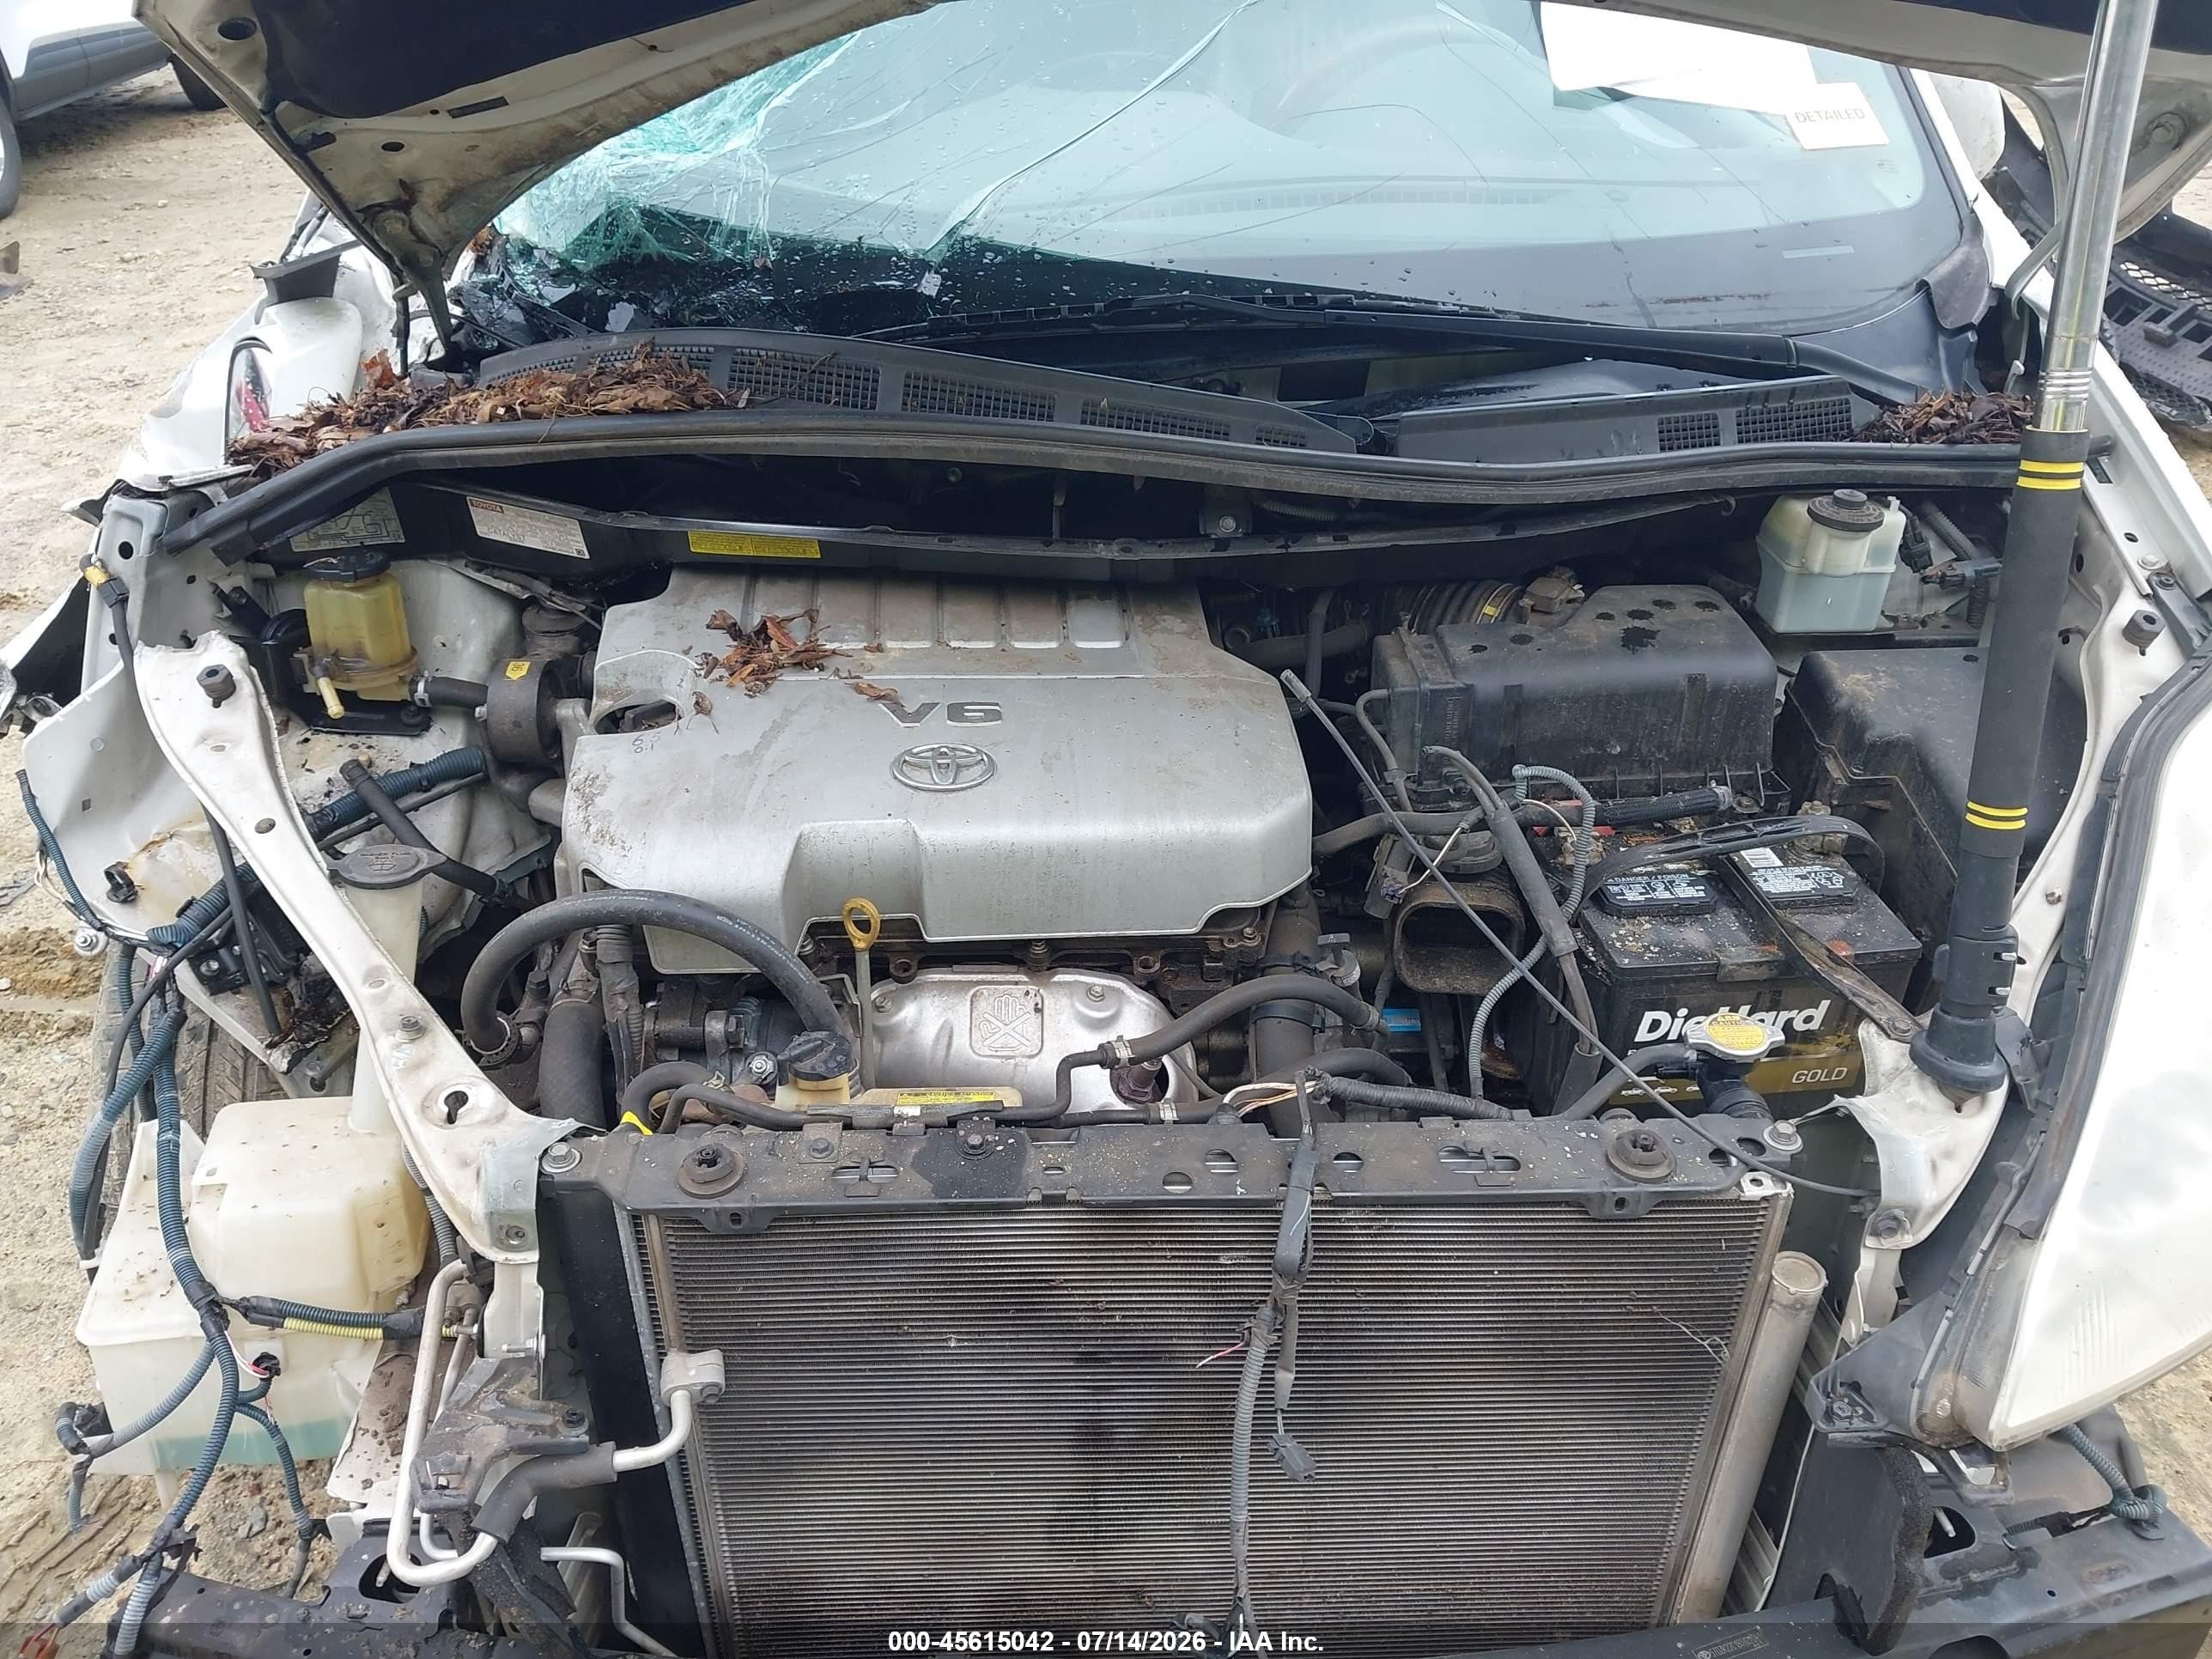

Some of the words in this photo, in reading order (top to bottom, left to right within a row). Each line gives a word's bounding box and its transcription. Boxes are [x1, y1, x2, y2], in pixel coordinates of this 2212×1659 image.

[1794, 108, 1866, 123] DETAILED
[472, 501, 502, 514] TOYOTA
[878, 702, 1003, 727] V6
[1614, 874, 1650, 883] DANGER
[1791, 1066, 1848, 1084] GOLD
